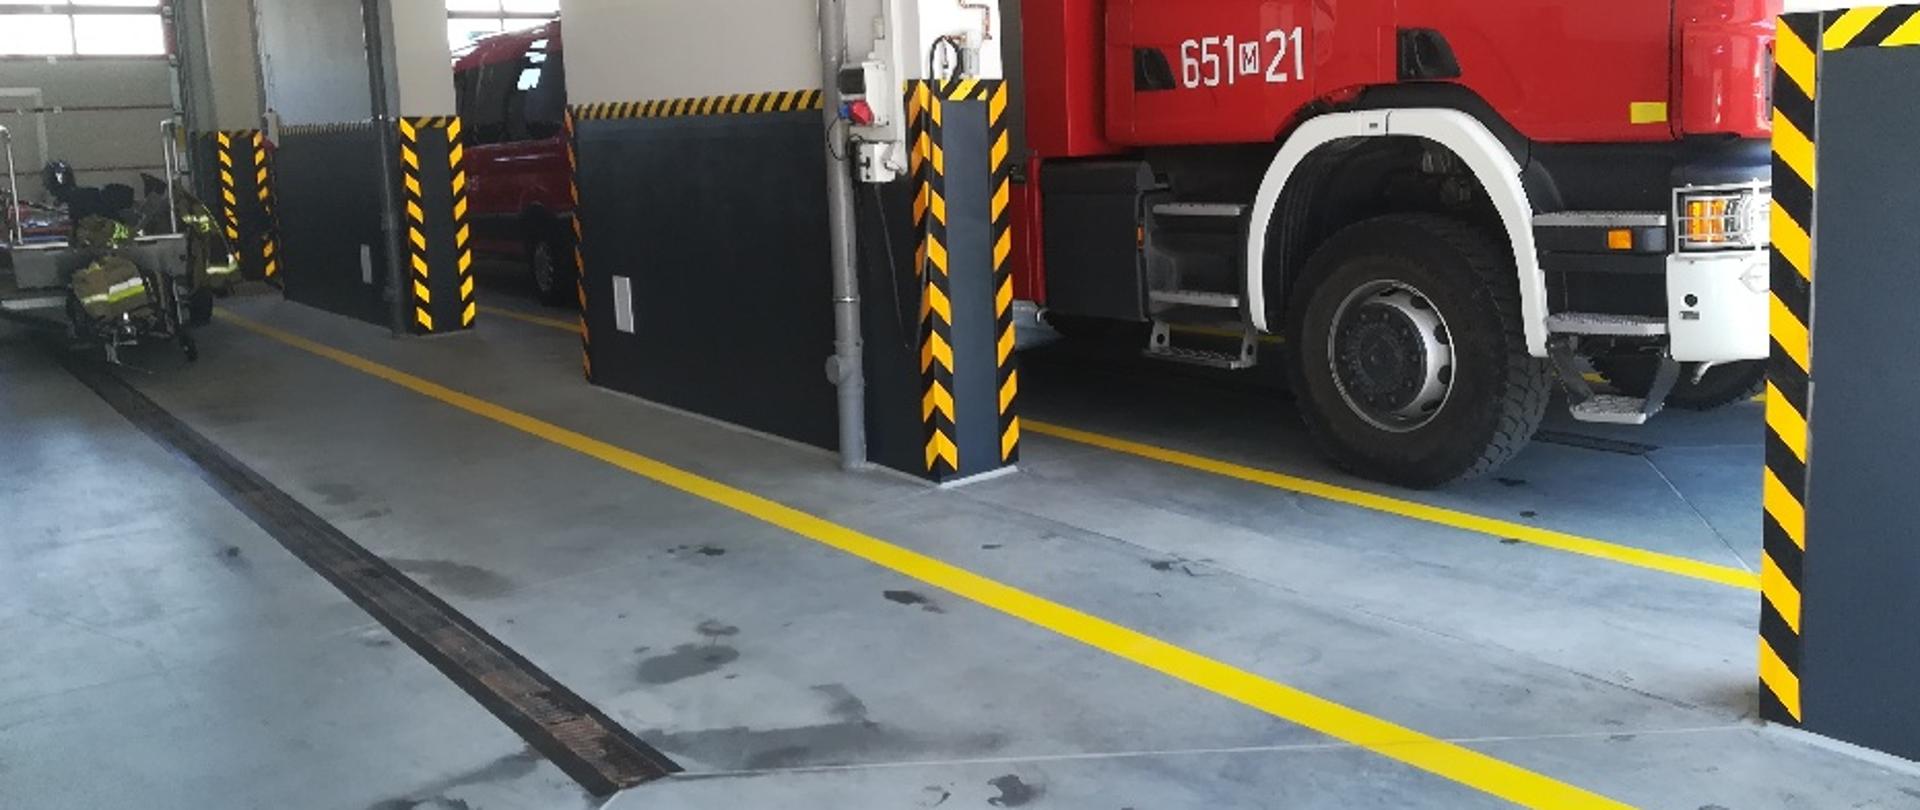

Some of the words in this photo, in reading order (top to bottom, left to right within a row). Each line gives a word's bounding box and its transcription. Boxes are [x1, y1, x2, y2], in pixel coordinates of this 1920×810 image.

[1181, 34, 1234, 88] 651
[1241, 44, 1258, 73] M
[1265, 26, 1304, 82] 21
